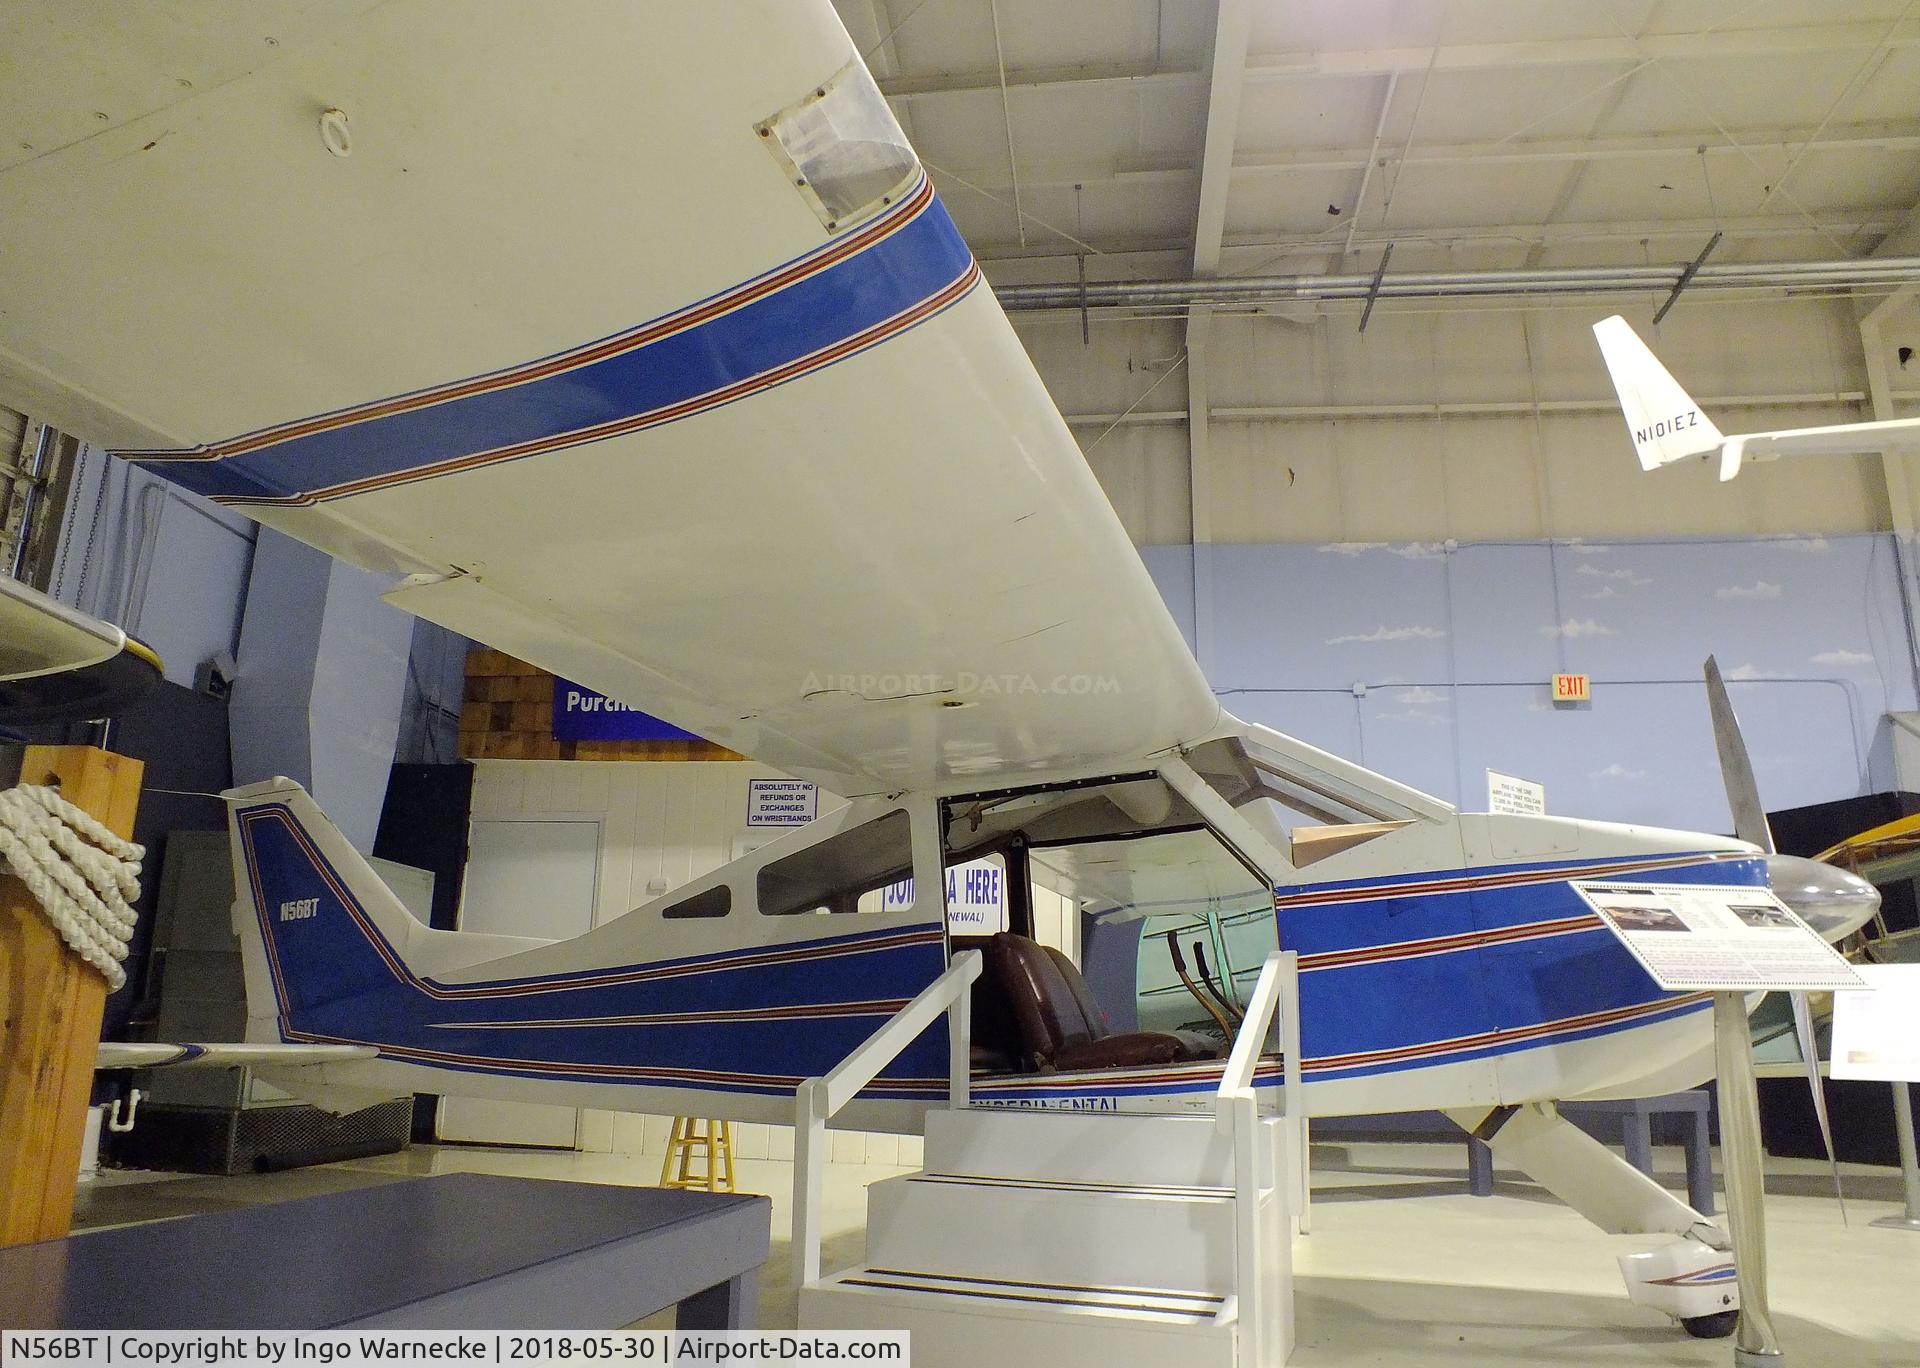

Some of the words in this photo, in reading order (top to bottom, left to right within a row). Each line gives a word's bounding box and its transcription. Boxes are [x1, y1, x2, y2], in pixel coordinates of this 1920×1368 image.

[1637, 411, 1697, 444] N101EZ
[1558, 676, 1584, 696] EXIT
[965, 869, 998, 904] HERE
[280, 897, 320, 922] N56BT
[969, 1097, 1117, 1111] PERIMENTAL
